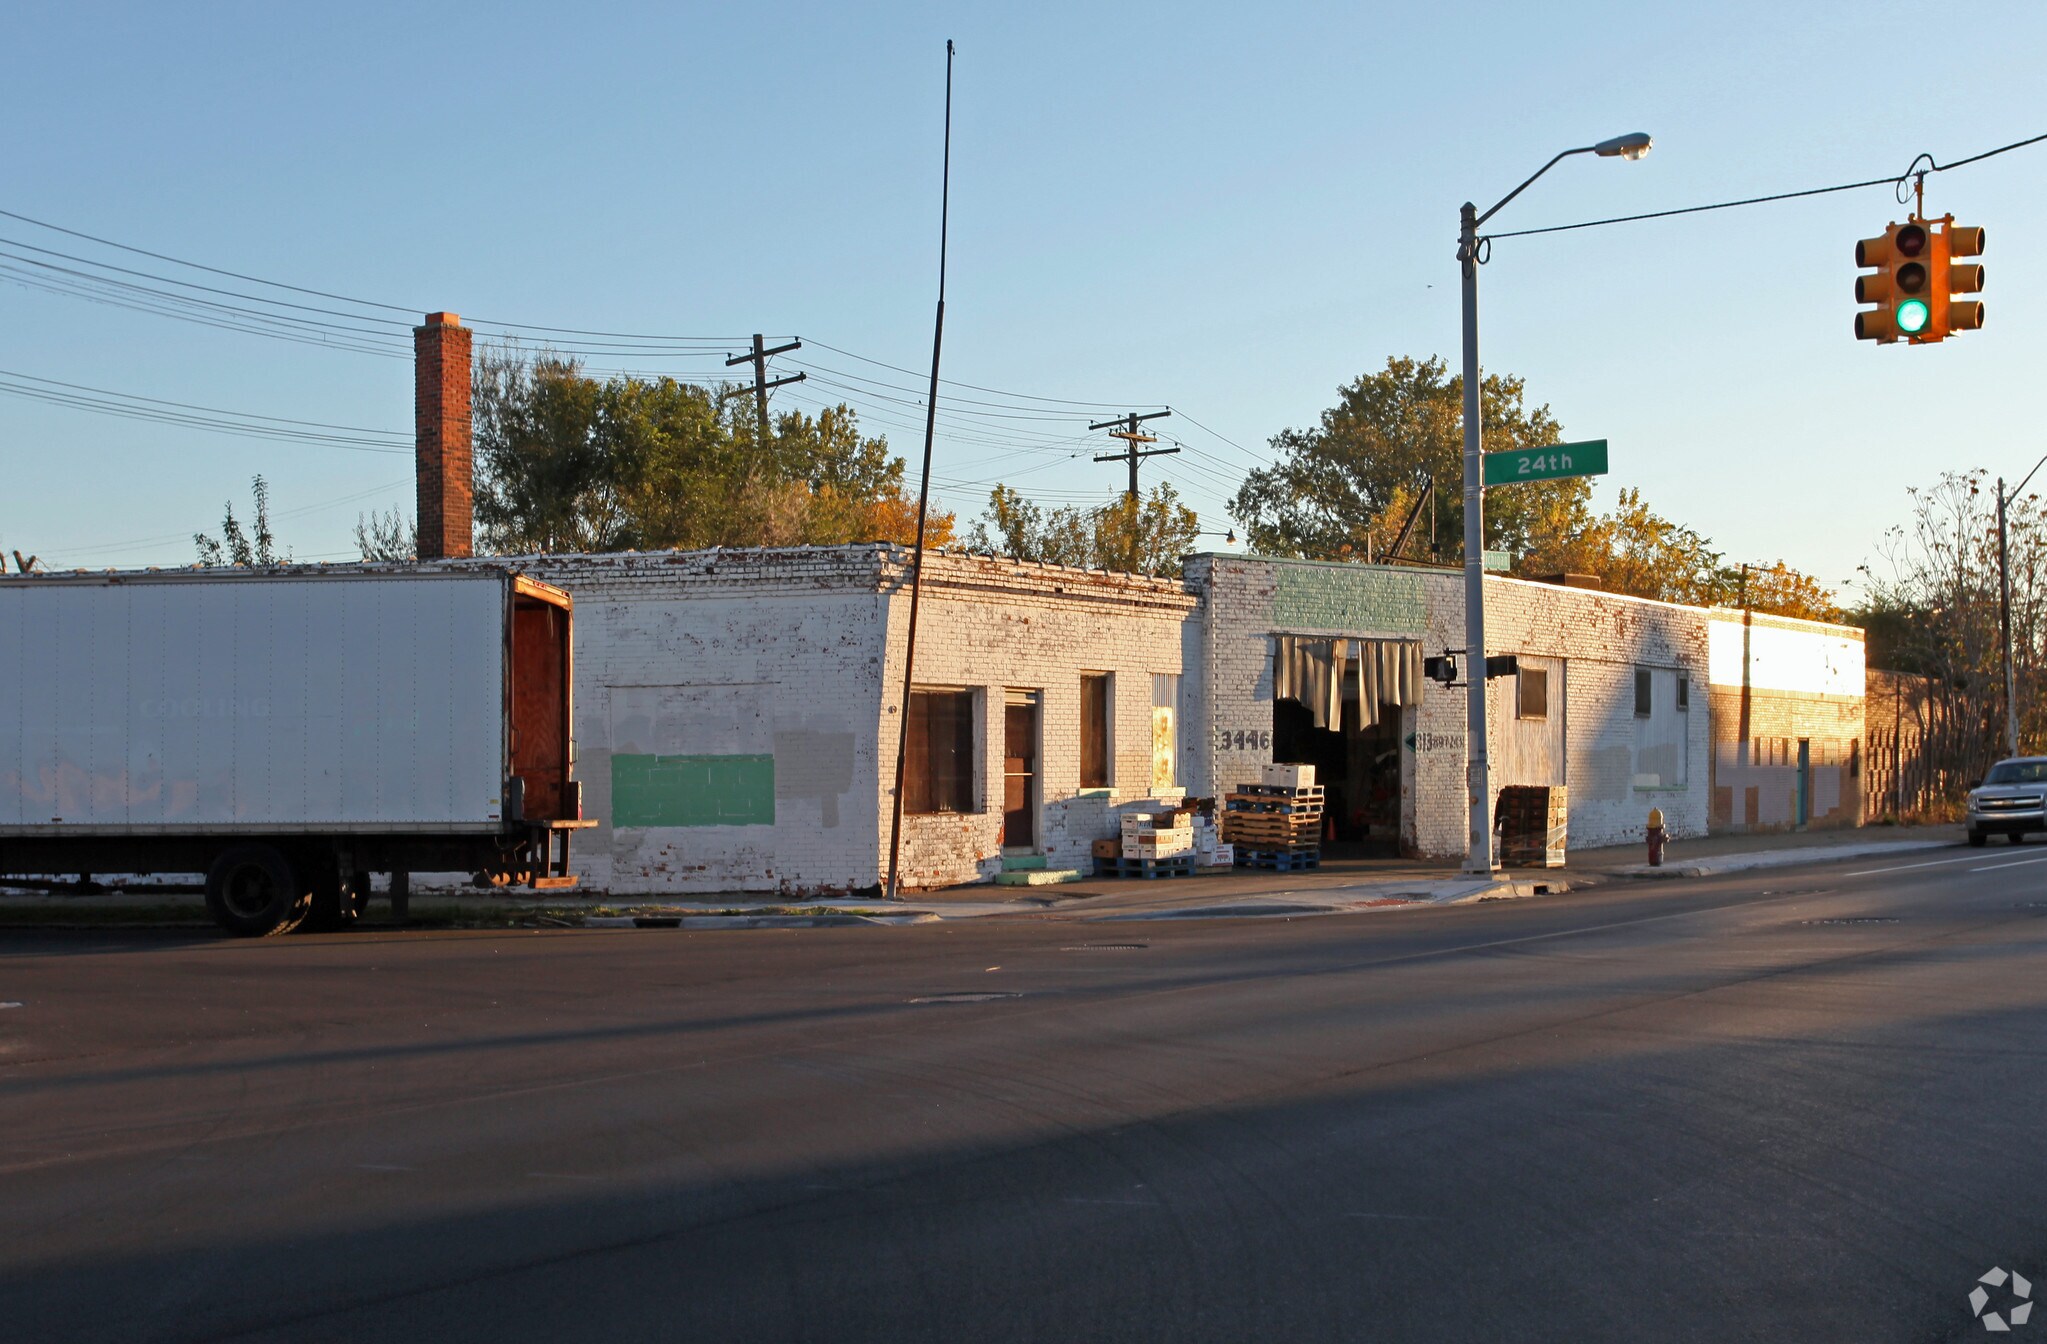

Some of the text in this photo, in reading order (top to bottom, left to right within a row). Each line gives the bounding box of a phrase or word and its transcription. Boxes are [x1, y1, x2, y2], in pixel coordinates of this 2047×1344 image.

[1517, 453, 1573, 475] 24th
[1485, 553, 1508, 567] ichigan
[139, 697, 271, 718] COOLING
[1220, 730, 1270, 750] 3446
